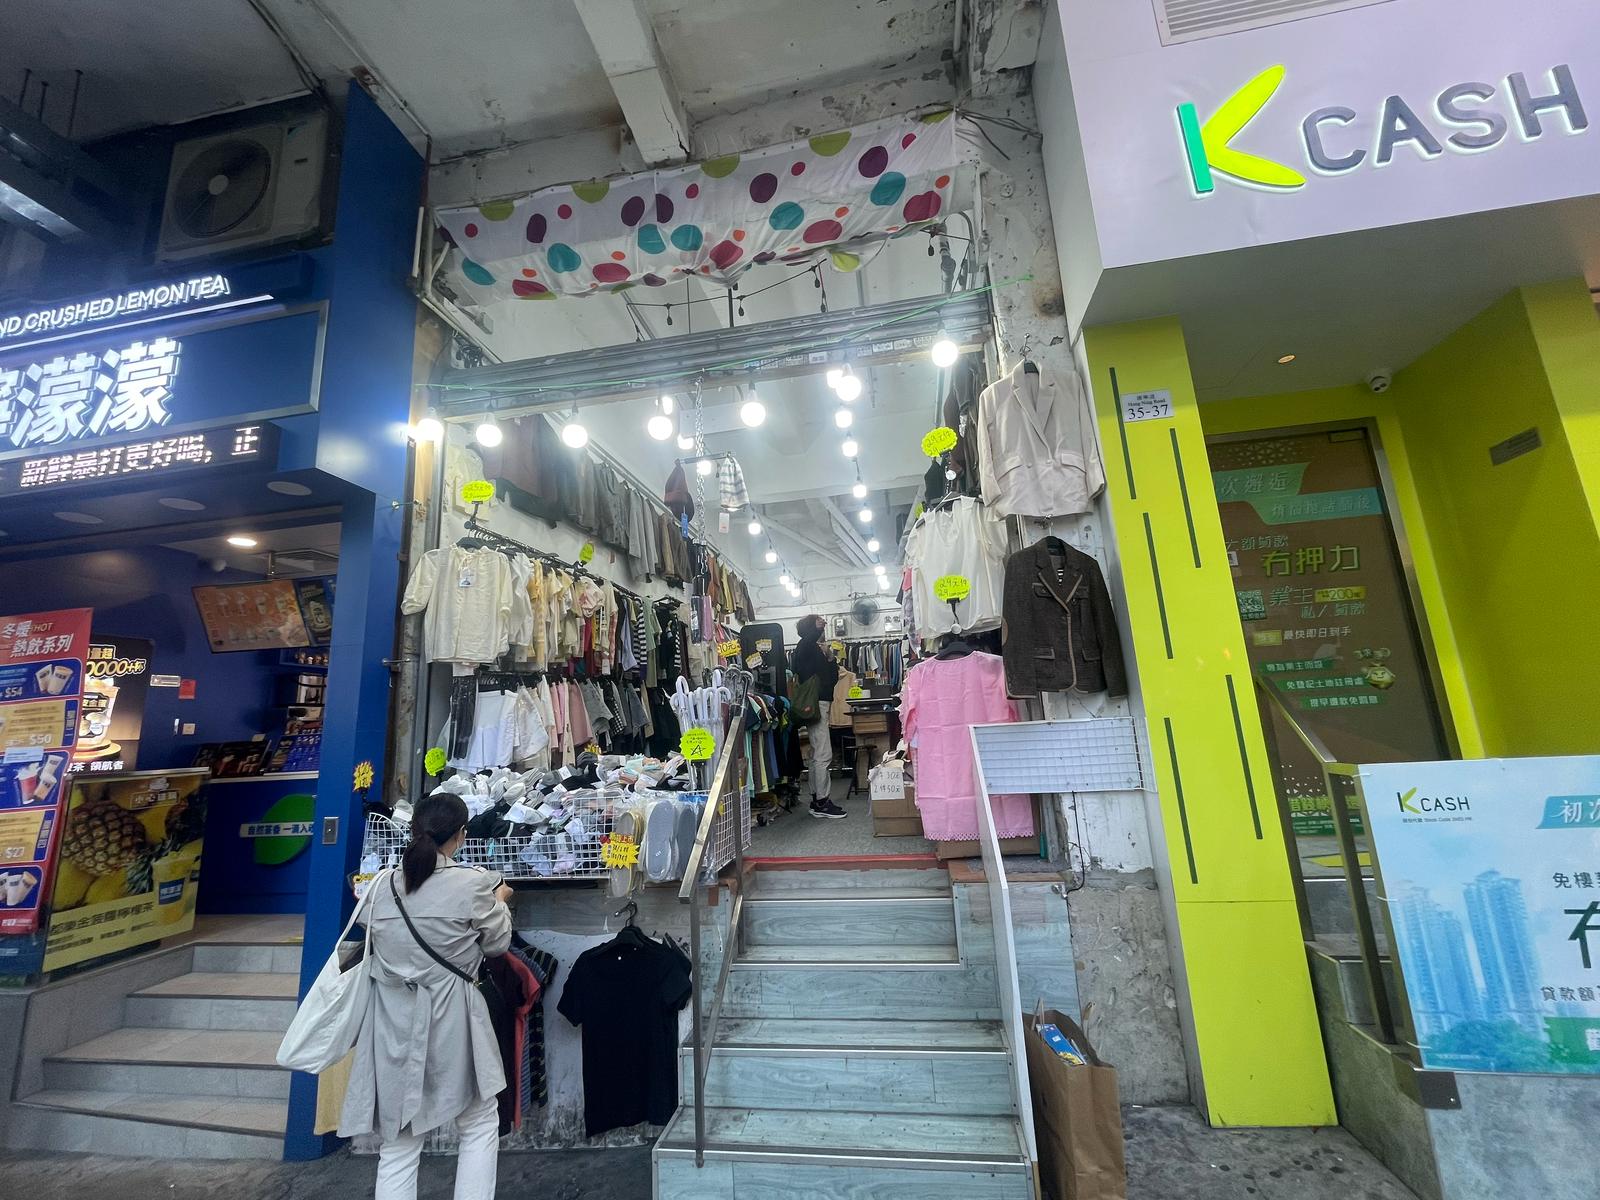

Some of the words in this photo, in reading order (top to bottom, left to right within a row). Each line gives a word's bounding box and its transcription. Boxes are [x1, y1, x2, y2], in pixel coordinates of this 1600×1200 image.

[24, 297, 115, 330] CRUSHED
[117, 284, 185, 311] LEMON
[188, 273, 229, 297] TEA
[1127, 404, 1168, 420] 35-37
[1283, 625, 1351, 641] 最快即日到手
[10, 633, 75, 658] 熱飲系列
